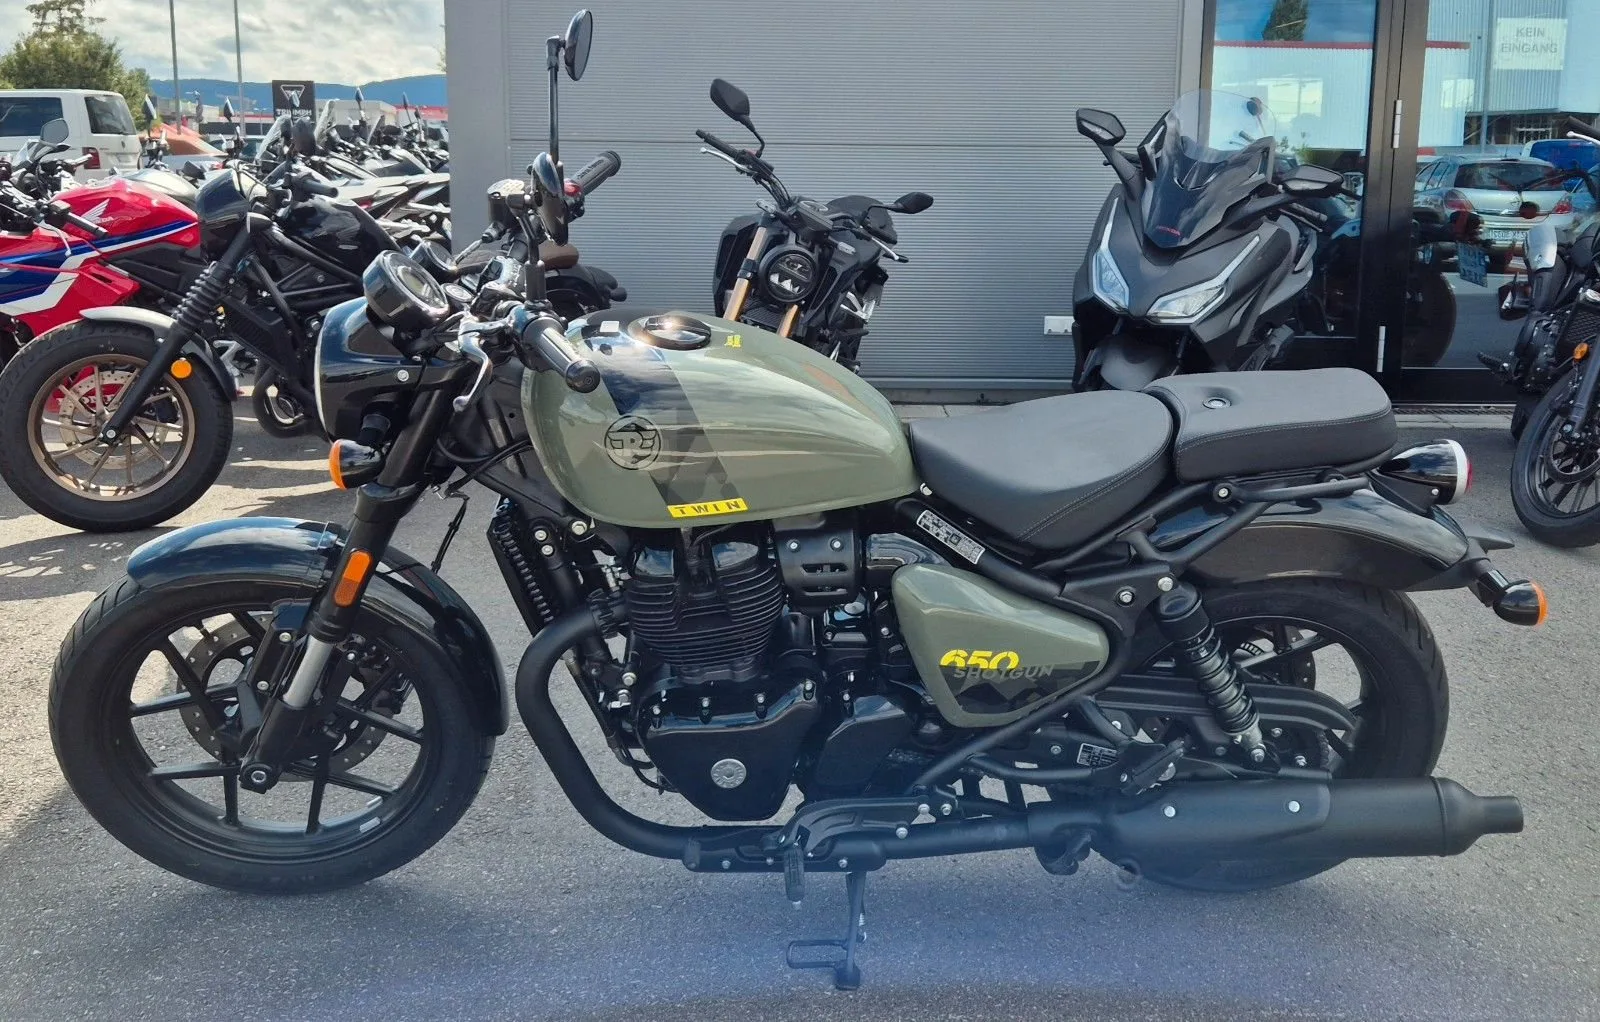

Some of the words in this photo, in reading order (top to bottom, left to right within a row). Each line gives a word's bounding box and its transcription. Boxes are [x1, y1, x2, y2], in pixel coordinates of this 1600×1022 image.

[1515, 26, 1545, 38] KEIN
[1501, 43, 1558, 54] EINGANG
[674, 500, 741, 515] TWIN
[940, 649, 1020, 670] 650
[953, 664, 1055, 680] SHOTGUN
